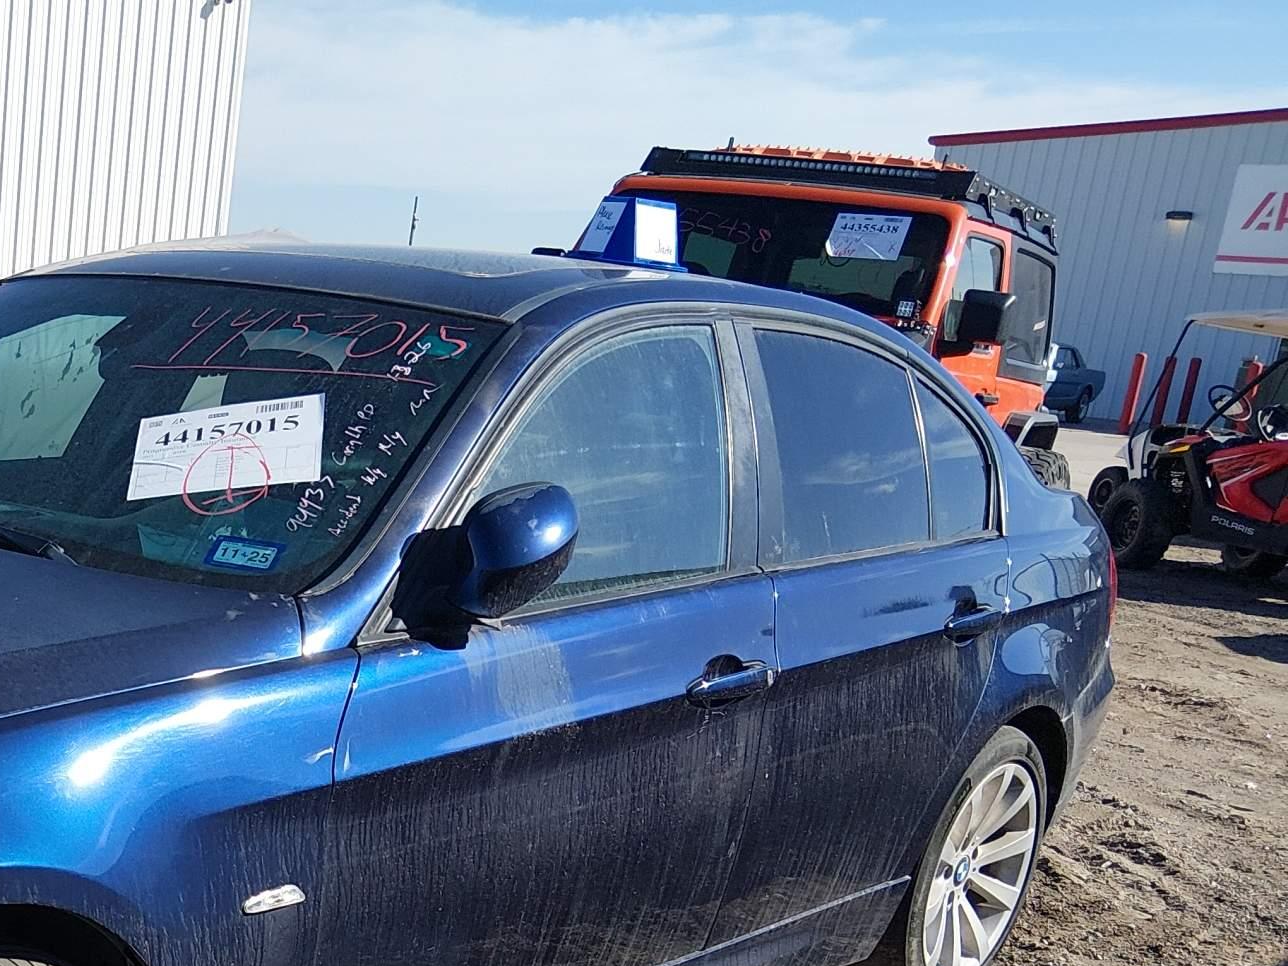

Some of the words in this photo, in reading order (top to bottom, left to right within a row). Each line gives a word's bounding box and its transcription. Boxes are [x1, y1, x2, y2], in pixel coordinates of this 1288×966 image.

[840, 222, 900, 234] 44355438
[167, 306, 475, 366] 44157015
[155, 415, 300, 447] 44157015
[1211, 515, 1256, 536] POLARIS
